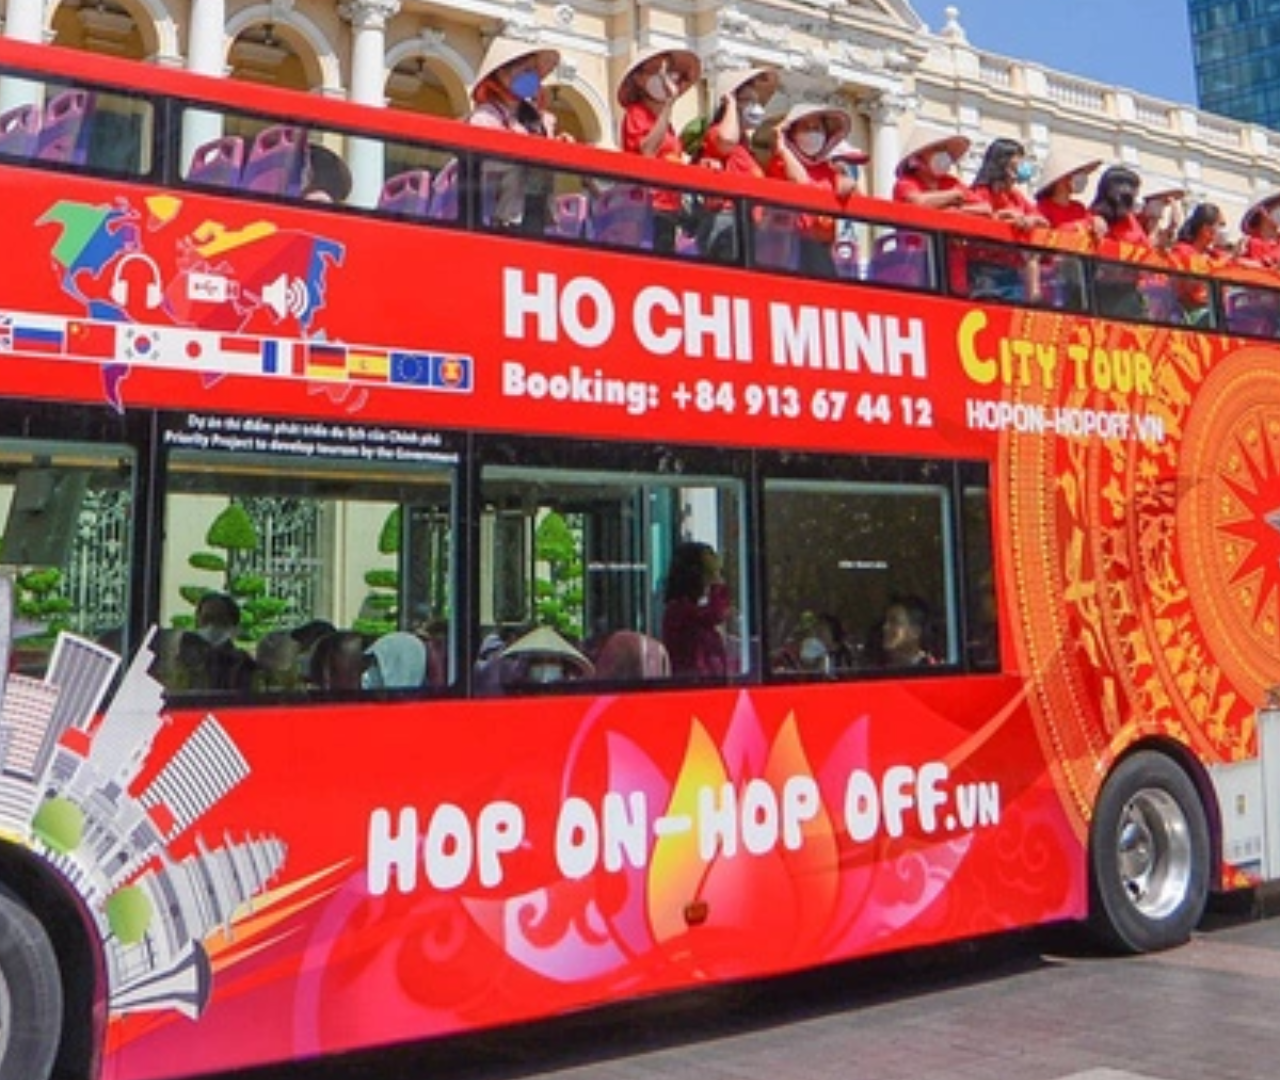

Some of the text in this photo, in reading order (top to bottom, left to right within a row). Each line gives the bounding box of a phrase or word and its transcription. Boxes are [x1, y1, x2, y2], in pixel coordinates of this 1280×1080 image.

[502, 266, 927, 379] HO CHI MINH
[501, 361, 934, 428] Booking: +84 913 67 44 12
[1067, 343, 1155, 397] TOUR
[965, 397, 1166, 444] HOPON-HOPOFF.VN
[366, 800, 524, 896] HOP
[844, 763, 1000, 842] OFF.VN
